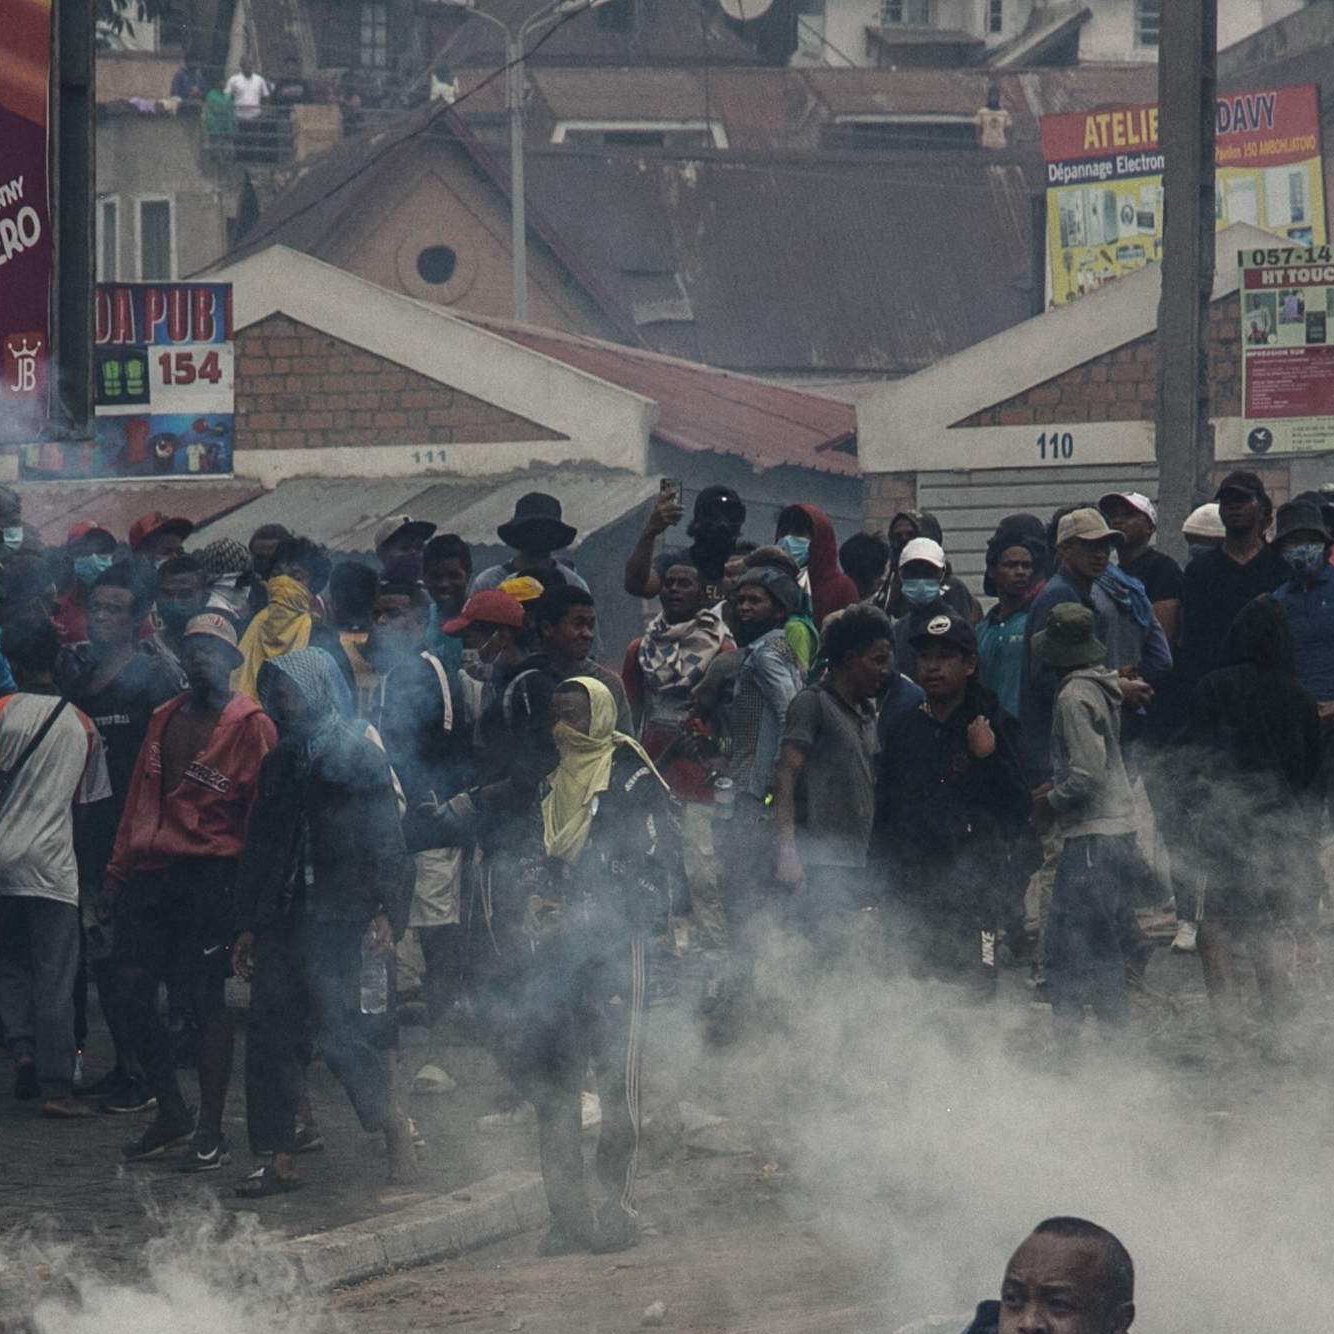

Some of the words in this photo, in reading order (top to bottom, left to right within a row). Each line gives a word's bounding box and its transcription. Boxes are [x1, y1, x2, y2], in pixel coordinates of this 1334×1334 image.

[1083, 107, 1160, 150] ATELIE
[1216, 92, 1277, 136] DAVY
[1048, 161, 1113, 184] Dépannage
[1116, 153, 1165, 175] Electron
[1262, 270, 1287, 285] HT
[143, 289, 217, 344] PUB
[10, 357, 37, 392] JB
[158, 351, 223, 385] 154
[412, 449, 447, 464] 111
[1036, 432, 1074, 460] 110
